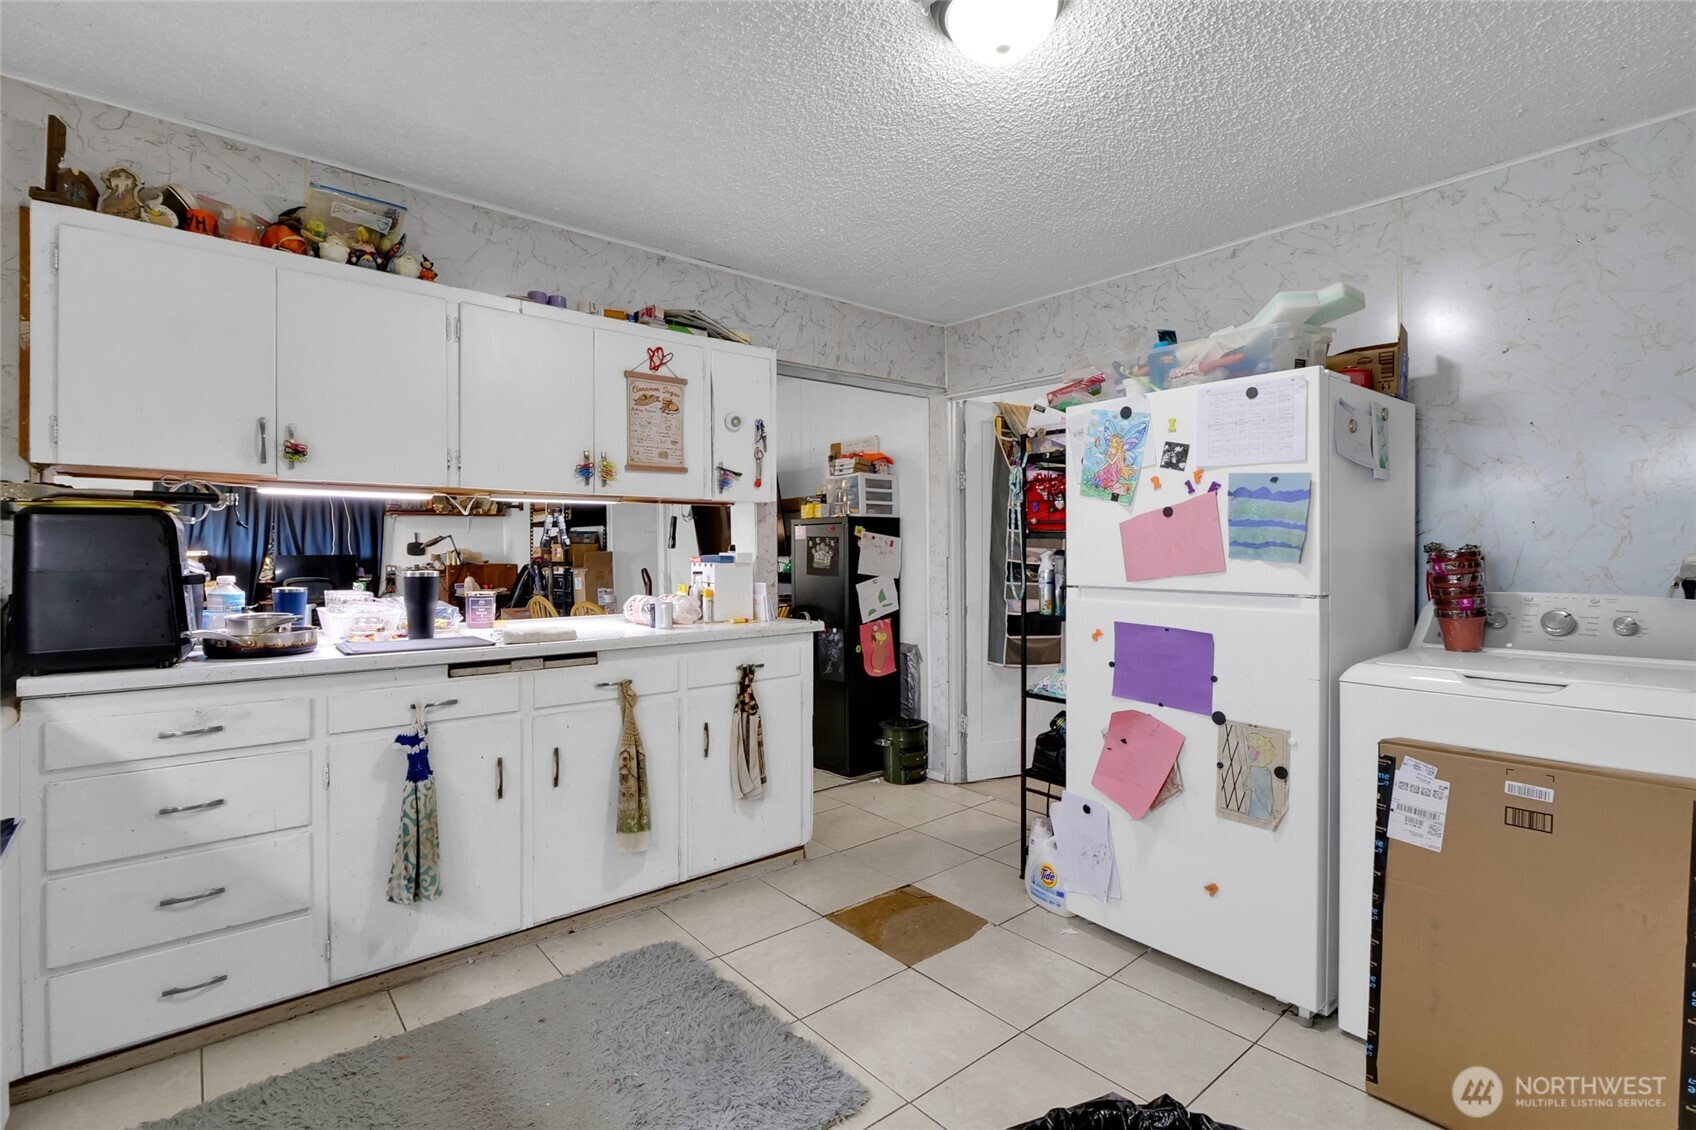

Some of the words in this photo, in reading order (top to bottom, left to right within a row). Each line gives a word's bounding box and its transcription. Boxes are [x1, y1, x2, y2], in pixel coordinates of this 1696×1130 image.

[632, 384, 660, 393] Cinnamon
[662, 386, 680, 398] Sugar
[1041, 868, 1055, 881] Tide
